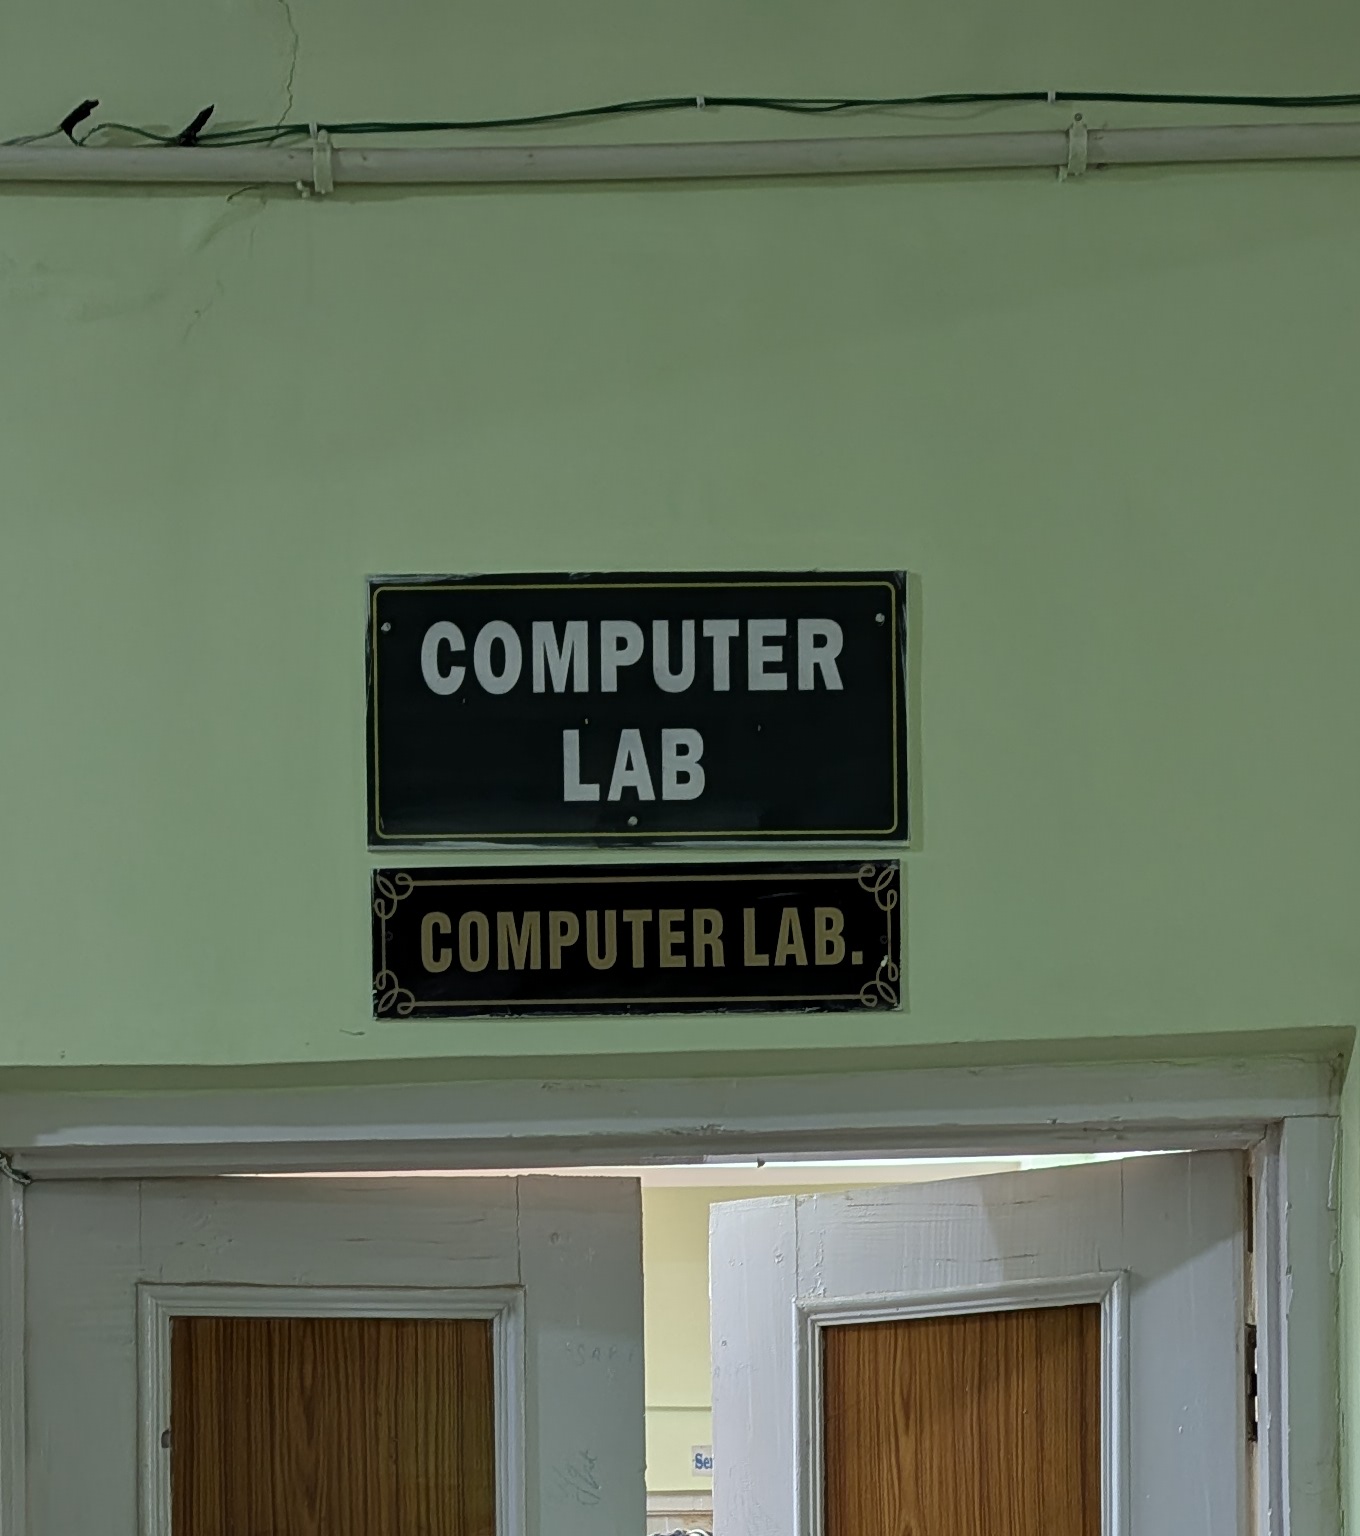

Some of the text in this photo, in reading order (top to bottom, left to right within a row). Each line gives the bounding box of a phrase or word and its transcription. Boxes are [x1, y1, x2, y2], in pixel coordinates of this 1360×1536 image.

[420, 618, 844, 696] COMPUTER
[562, 728, 706, 802] LAB
[420, 906, 864, 973] COMPUTER LAB.
